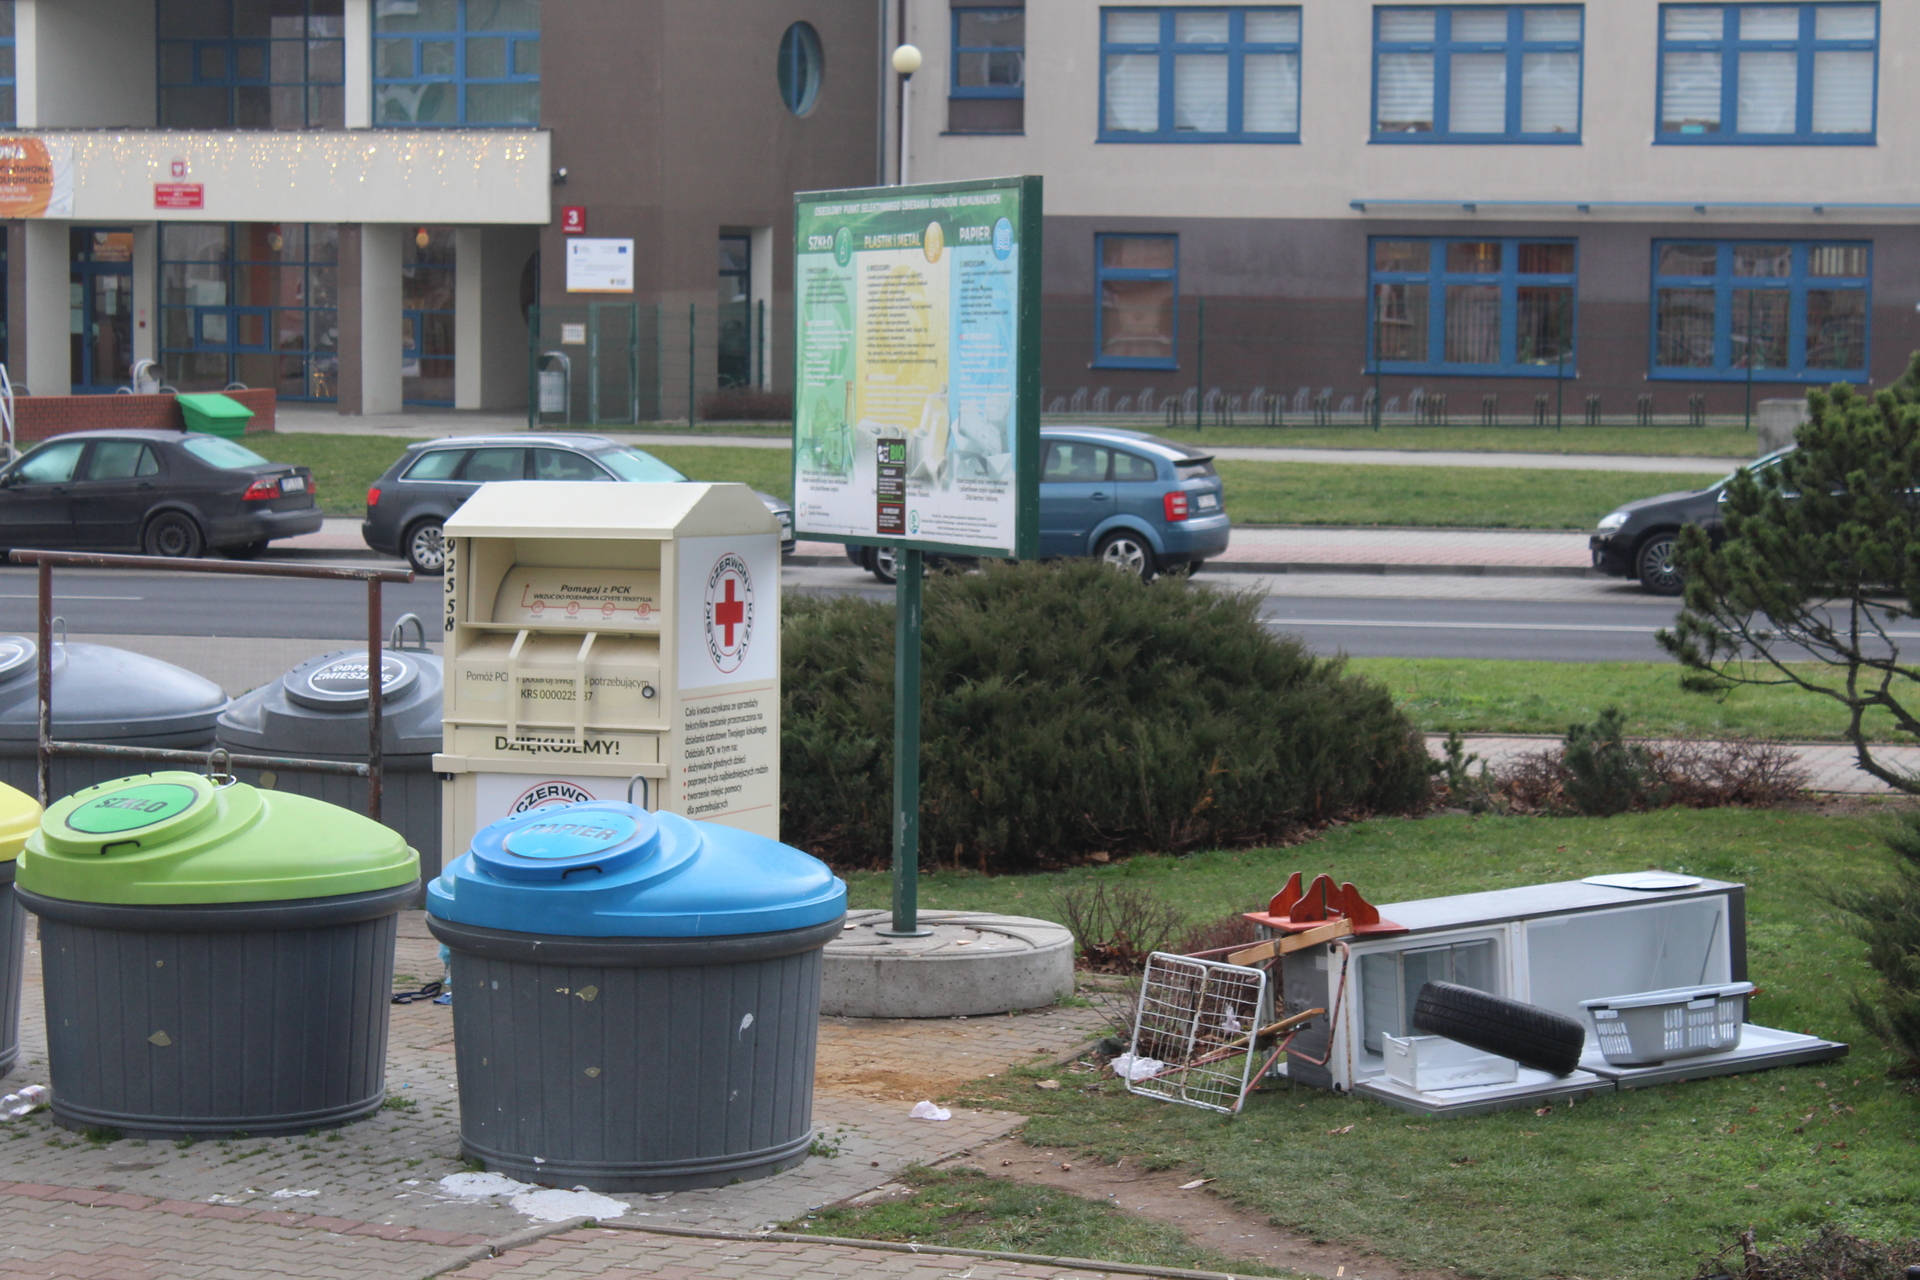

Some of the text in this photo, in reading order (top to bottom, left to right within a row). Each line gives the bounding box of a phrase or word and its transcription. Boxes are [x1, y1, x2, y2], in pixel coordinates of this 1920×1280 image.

[568, 210, 579, 225] 3
[808, 235, 834, 250] SZKŁO
[864, 234, 892, 249] PLASTIK
[898, 232, 921, 248] METAL
[959, 226, 991, 242] PAPIER
[890, 444, 905, 461] BIO
[709, 558, 752, 592] CZERWONY
[560, 584, 632, 594] Pomagaj z PCK
[706, 602, 722, 664] POLSKI
[332, 664, 390, 672] ODPAY
[314, 672, 394, 682] ZMIESZE
[466, 670, 493, 682] Pomóż
[589, 675, 650, 690] potrzebującym
[520, 688, 593, 701] KRS 00002257
[685, 707, 696, 717] Cała
[696, 706, 710, 715] kwota
[711, 704, 730, 714] uzyskana
[736, 699, 759, 712] sprzedaży
[708, 717, 726, 727] zostanie
[727, 714, 756, 726] przeznaczona
[684, 734, 705, 745] działania
[706, 730, 727, 742] statutowe
[728, 728, 746, 738] Twojego
[684, 748, 705, 759] Oddziału
[706, 746, 716, 755] PCK
[721, 745, 730, 755] tym
[688, 754, 746, 774] dożywianie głodnych dzieci
[708, 773, 718, 785] życia
[754, 764, 768, 774] rodzin
[688, 784, 742, 801] tworzenie miejsc pomocy
[94, 798, 168, 813] SZKŁO
[521, 823, 619, 841] PAPIER
